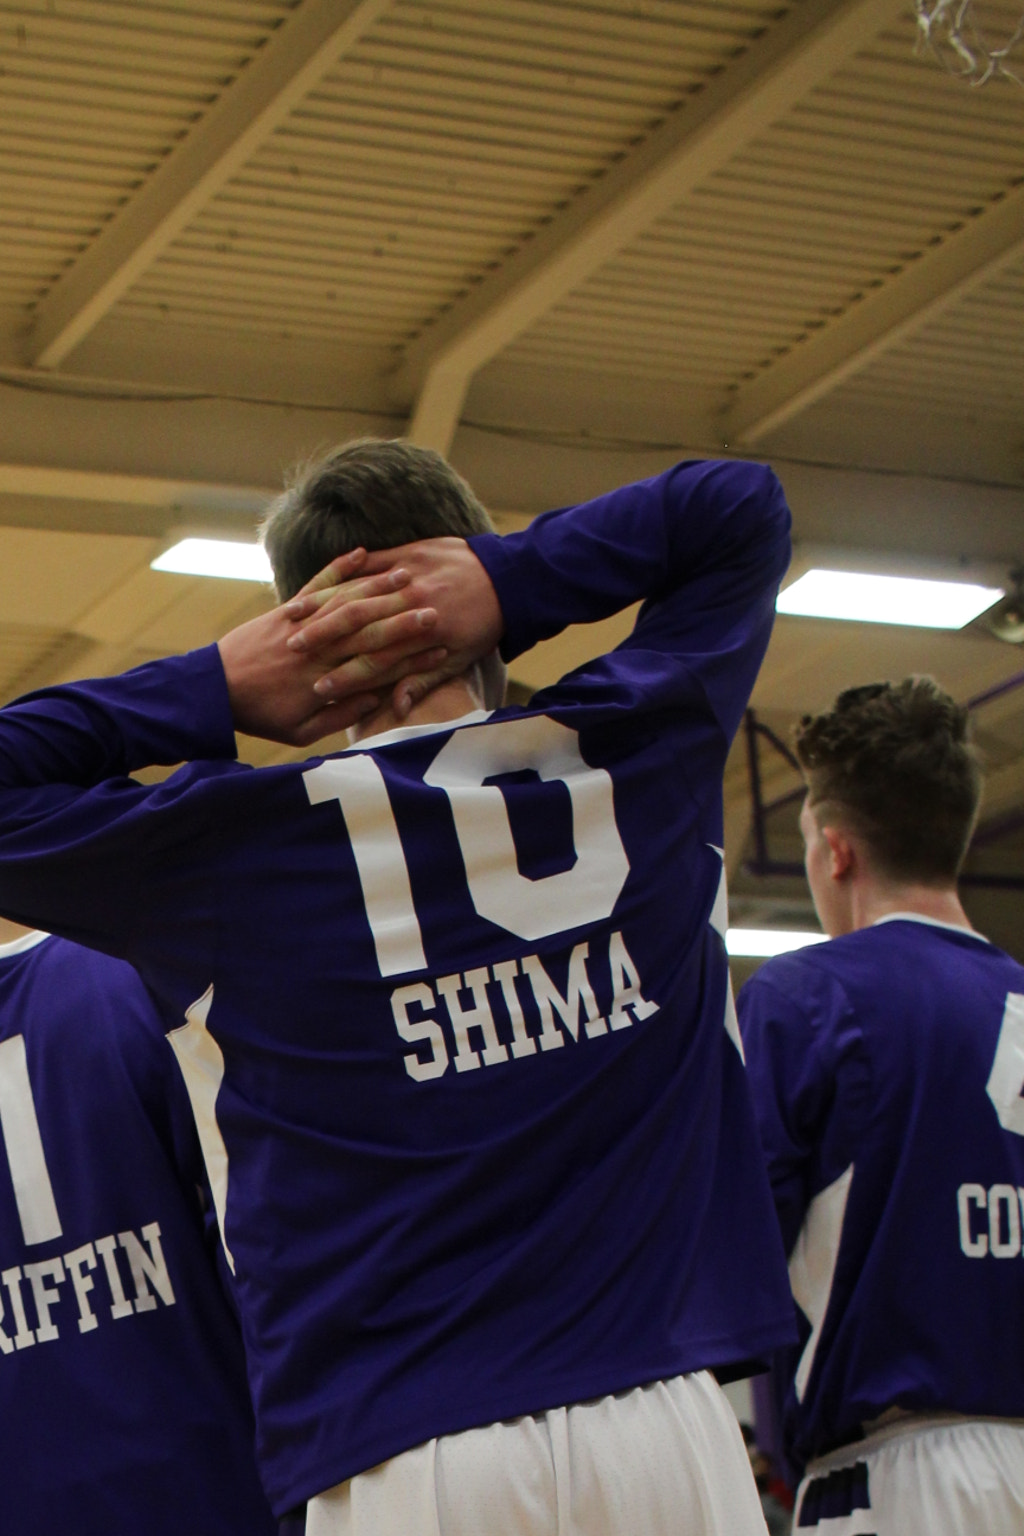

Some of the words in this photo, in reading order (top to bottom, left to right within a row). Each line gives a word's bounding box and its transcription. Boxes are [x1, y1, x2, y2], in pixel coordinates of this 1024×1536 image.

[302, 714, 631, 978] 10
[389, 930, 661, 1083] SHIMA
[956, 1182, 1024, 1259] CO
